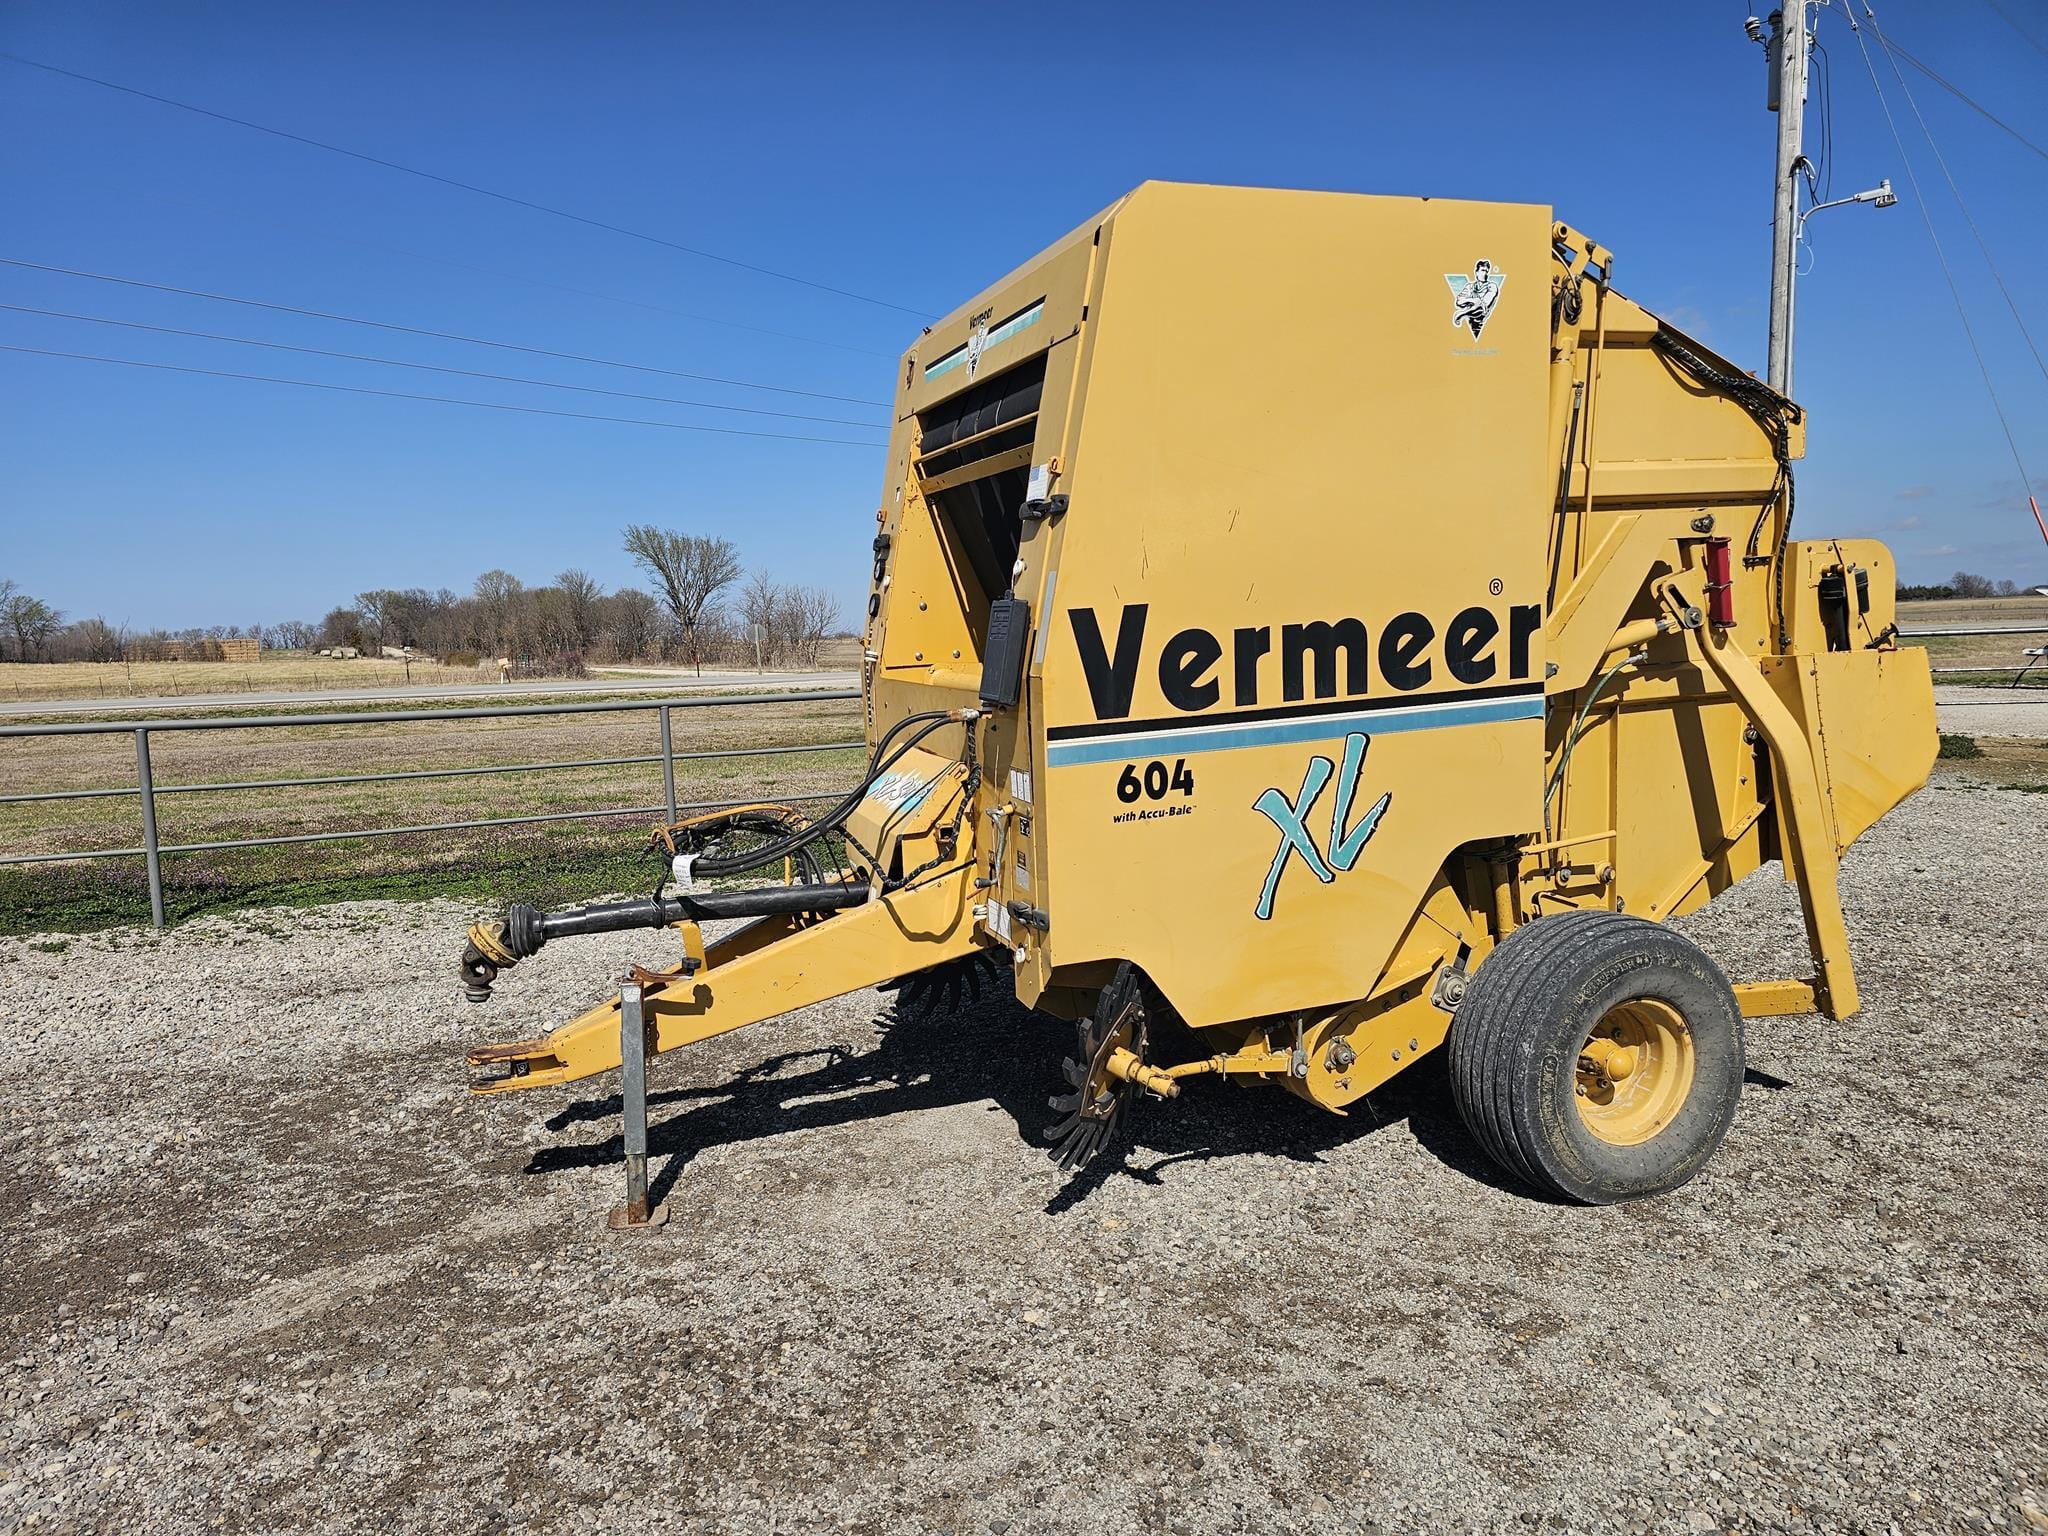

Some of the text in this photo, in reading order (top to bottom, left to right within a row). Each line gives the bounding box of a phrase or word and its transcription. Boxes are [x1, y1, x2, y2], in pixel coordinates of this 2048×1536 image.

[1117, 759, 1194, 804] 604
[1113, 811, 1136, 824] with
[1252, 732, 1392, 920] XL
